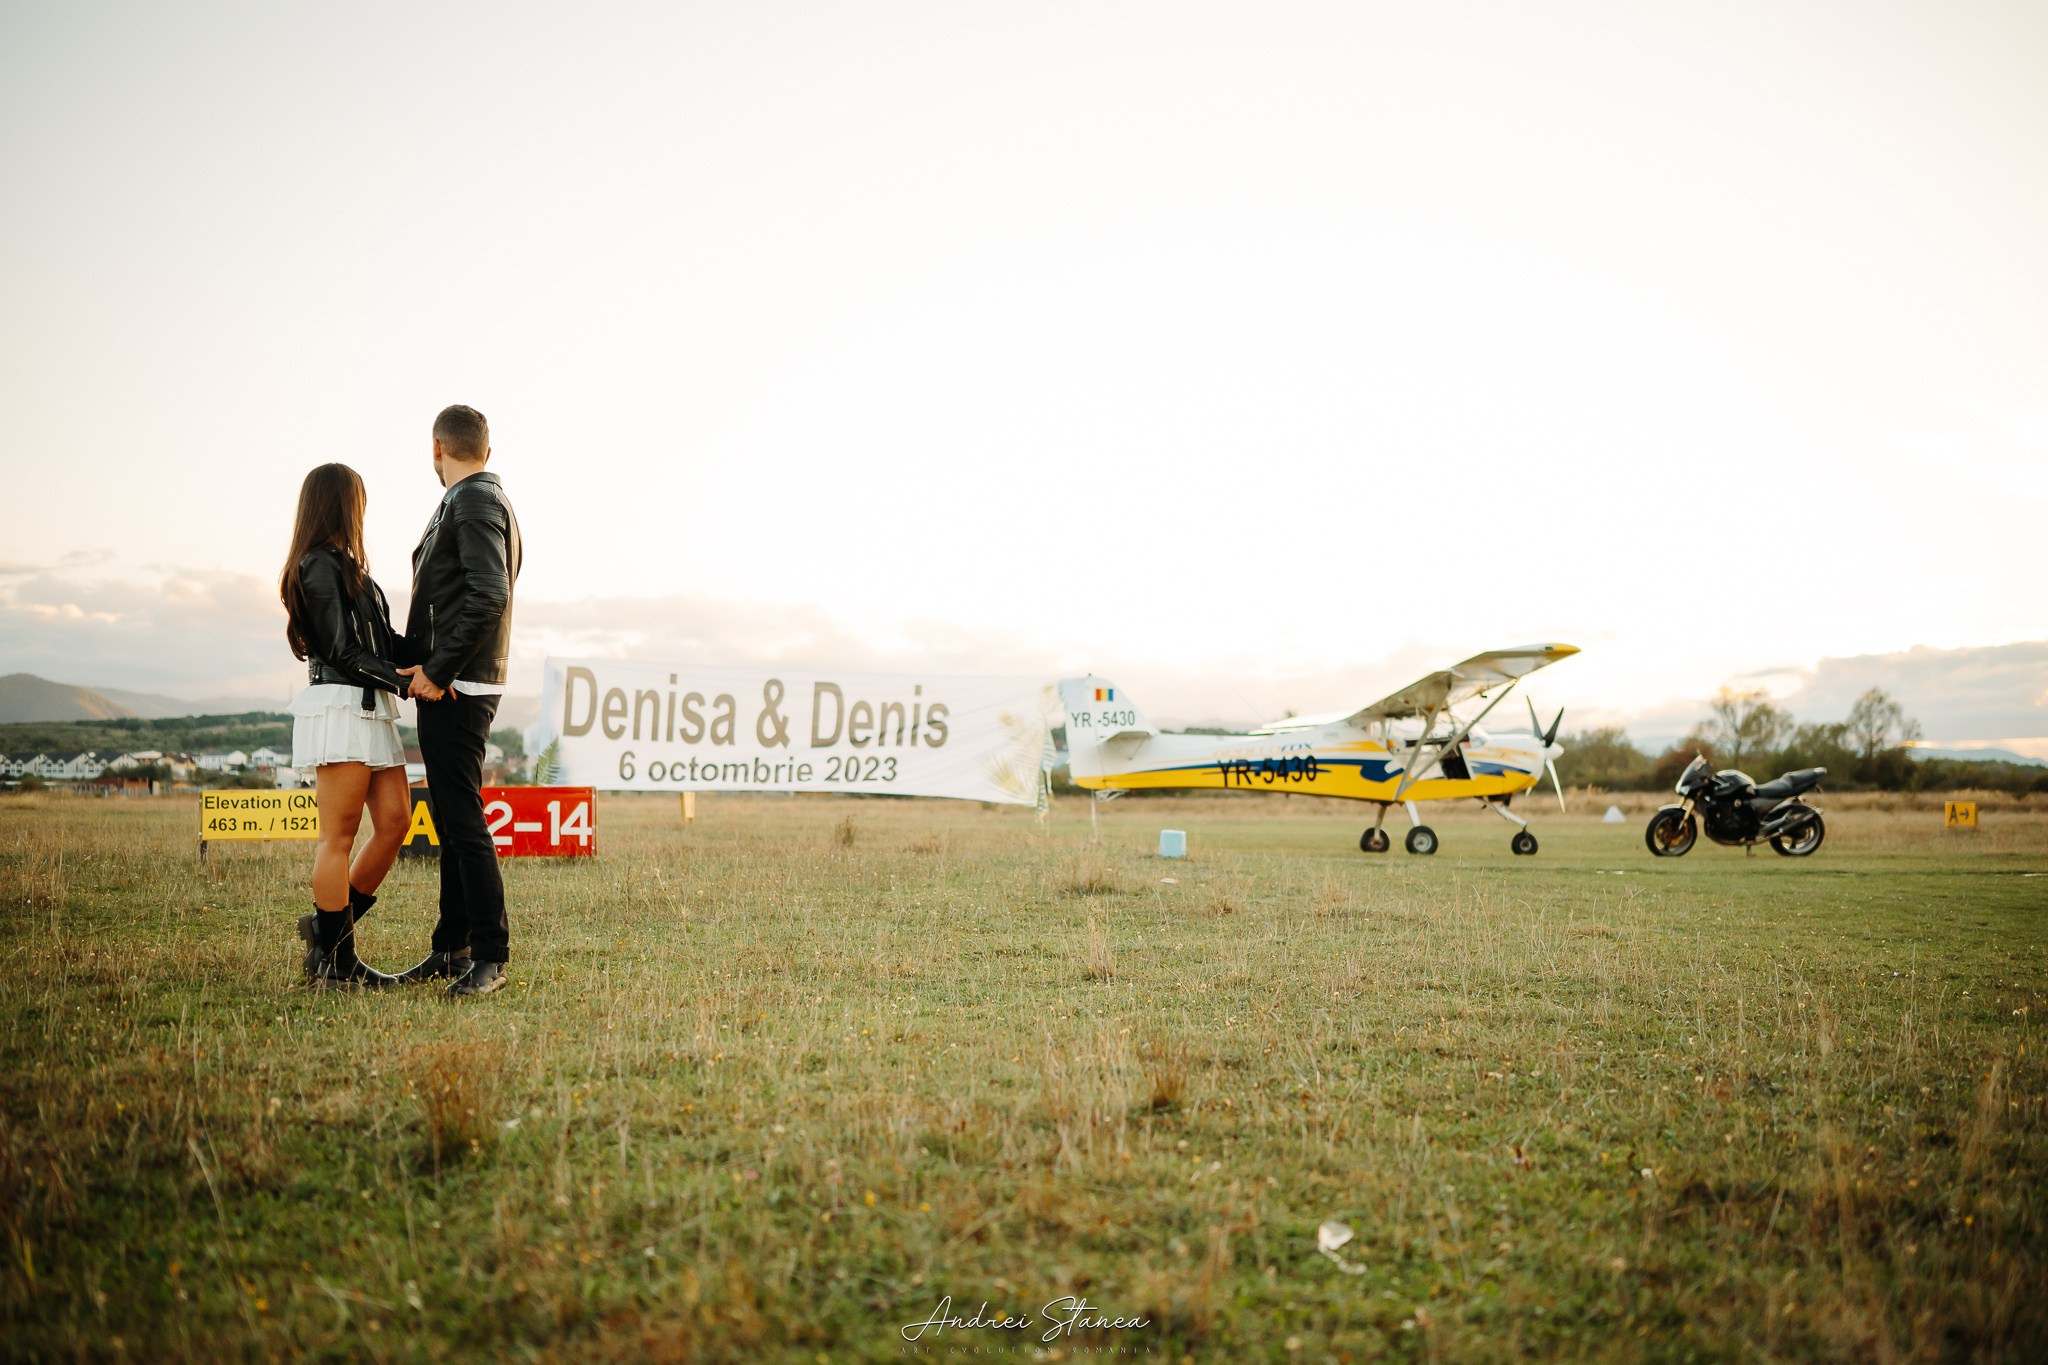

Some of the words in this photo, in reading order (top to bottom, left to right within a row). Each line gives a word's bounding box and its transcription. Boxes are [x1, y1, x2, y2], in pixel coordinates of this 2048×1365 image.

[563, 666, 737, 746] Denisa
[756, 678, 790, 749] &
[811, 681, 950, 748] Denis
[618, 751, 636, 781] 6
[648, 755, 814, 784] octombrie
[825, 756, 898, 782] 2023
[1217, 755, 1317, 788] YR-5430
[205, 796, 281, 810] Elevation
[1949, 804, 1959, 823] A
[208, 818, 237, 831] 463
[243, 820, 262, 831] m.
[281, 817, 317, 830] 1521
[402, 800, 440, 846] A
